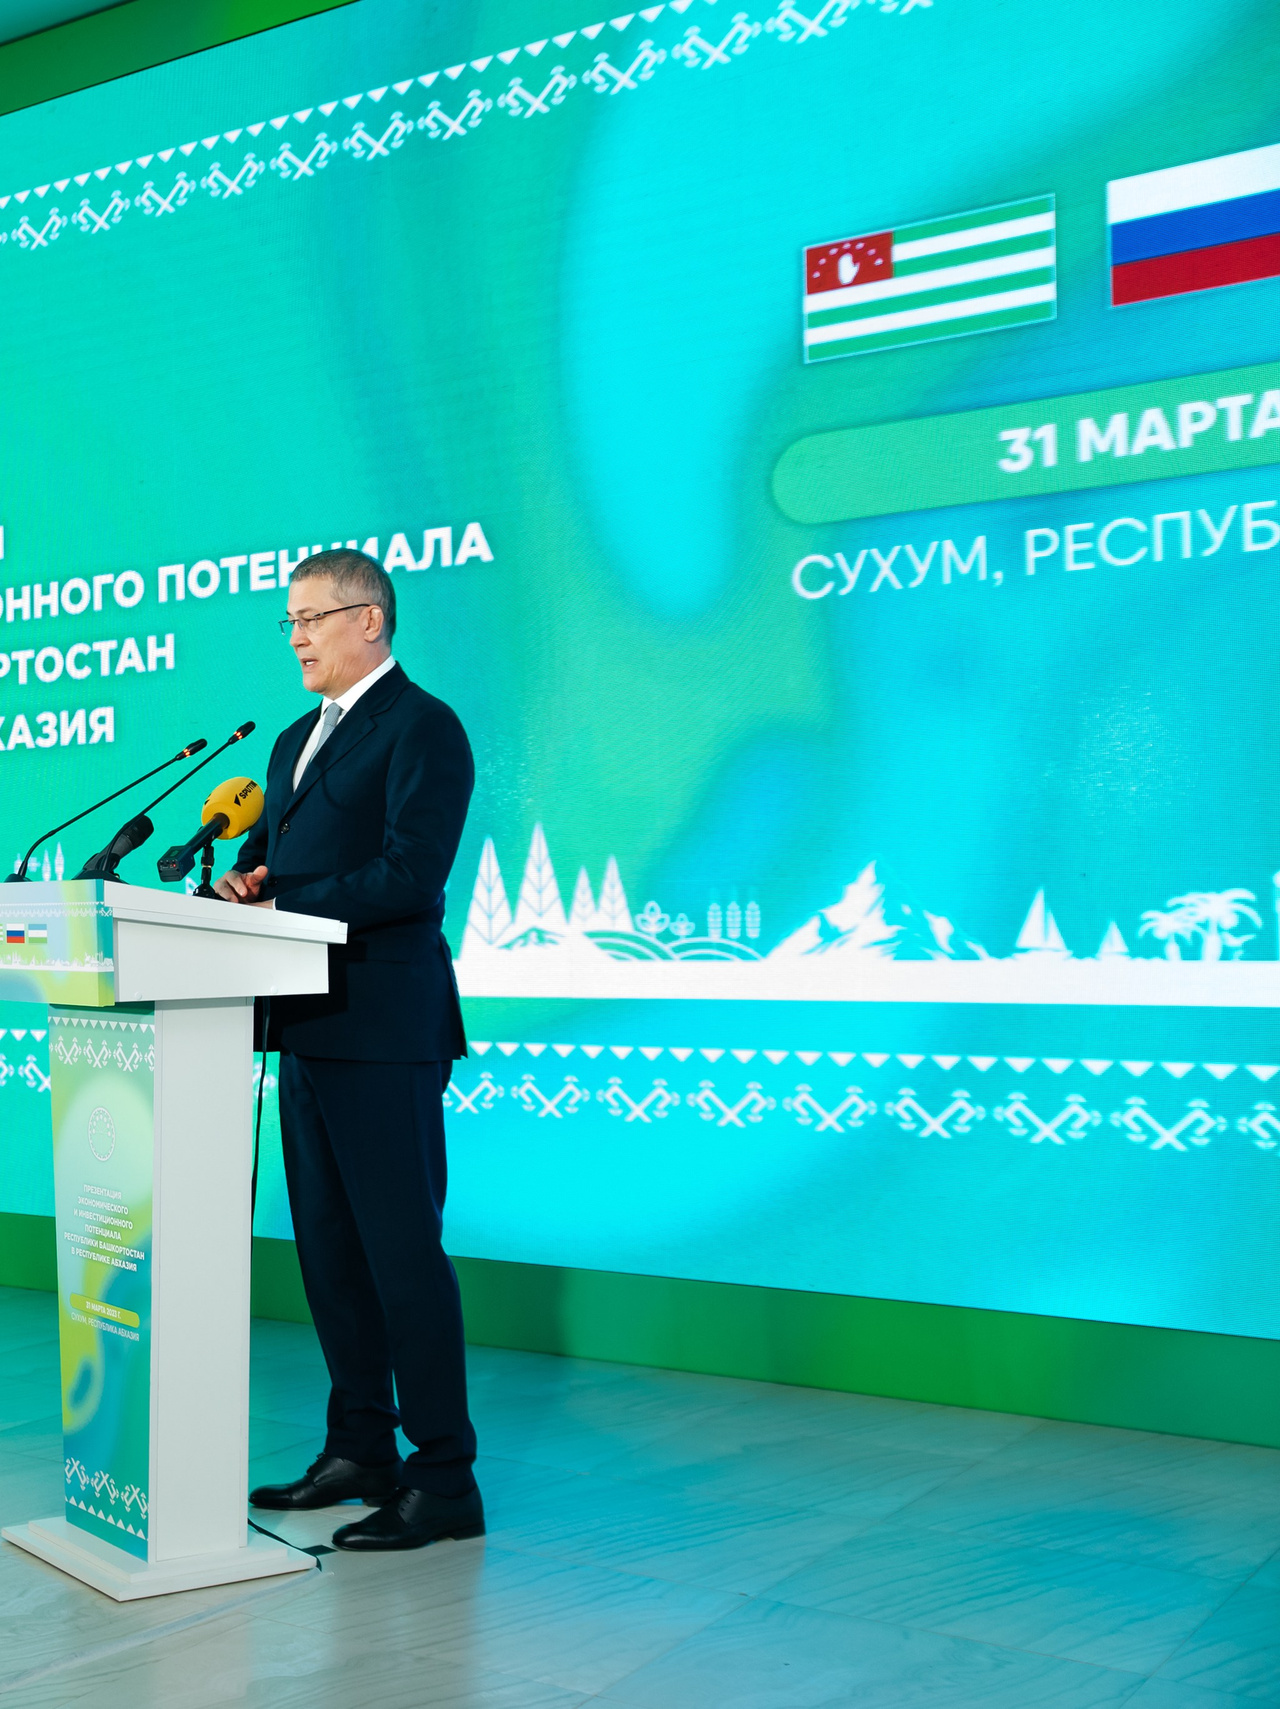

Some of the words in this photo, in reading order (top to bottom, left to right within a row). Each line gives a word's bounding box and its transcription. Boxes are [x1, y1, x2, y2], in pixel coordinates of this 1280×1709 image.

[998, 424, 1057, 473] 31
[1077, 389, 1280, 463] МАРТА
[791, 534, 1003, 600] СУХУМ,
[1024, 499, 1280, 576] РЕСПУБ
[158, 522, 494, 603] ПОТЕНАЛА
[83, 1184, 122, 1200] ПРЕЗЕНТАЦИЯ
[78, 1196, 129, 1215] ЭКОНОМИЧЕСКОГО
[73, 1208, 78, 1216] И
[78, 1209, 133, 1230] ИНВЕСТИЦИОННОГО
[84, 1224, 122, 1241] ПОТЕНЦИАЛА
[64, 1231, 98, 1248] РЕСПУБЛИКИ
[99, 1240, 145, 1260] БАШКОРТОСТАН
[71, 1246, 76, 1255] В
[76, 1248, 110, 1265] РЕСПУБЛИКЕ
[111, 1258, 137, 1272] АБХАЗИЯ
[85, 1301, 90, 1309] 31
[91, 1303, 106, 1314] МАРТА
[88, 1317, 118, 1335] РЕСПУБЛИКА
[118, 1327, 140, 1341] АБХАЗИЯ
